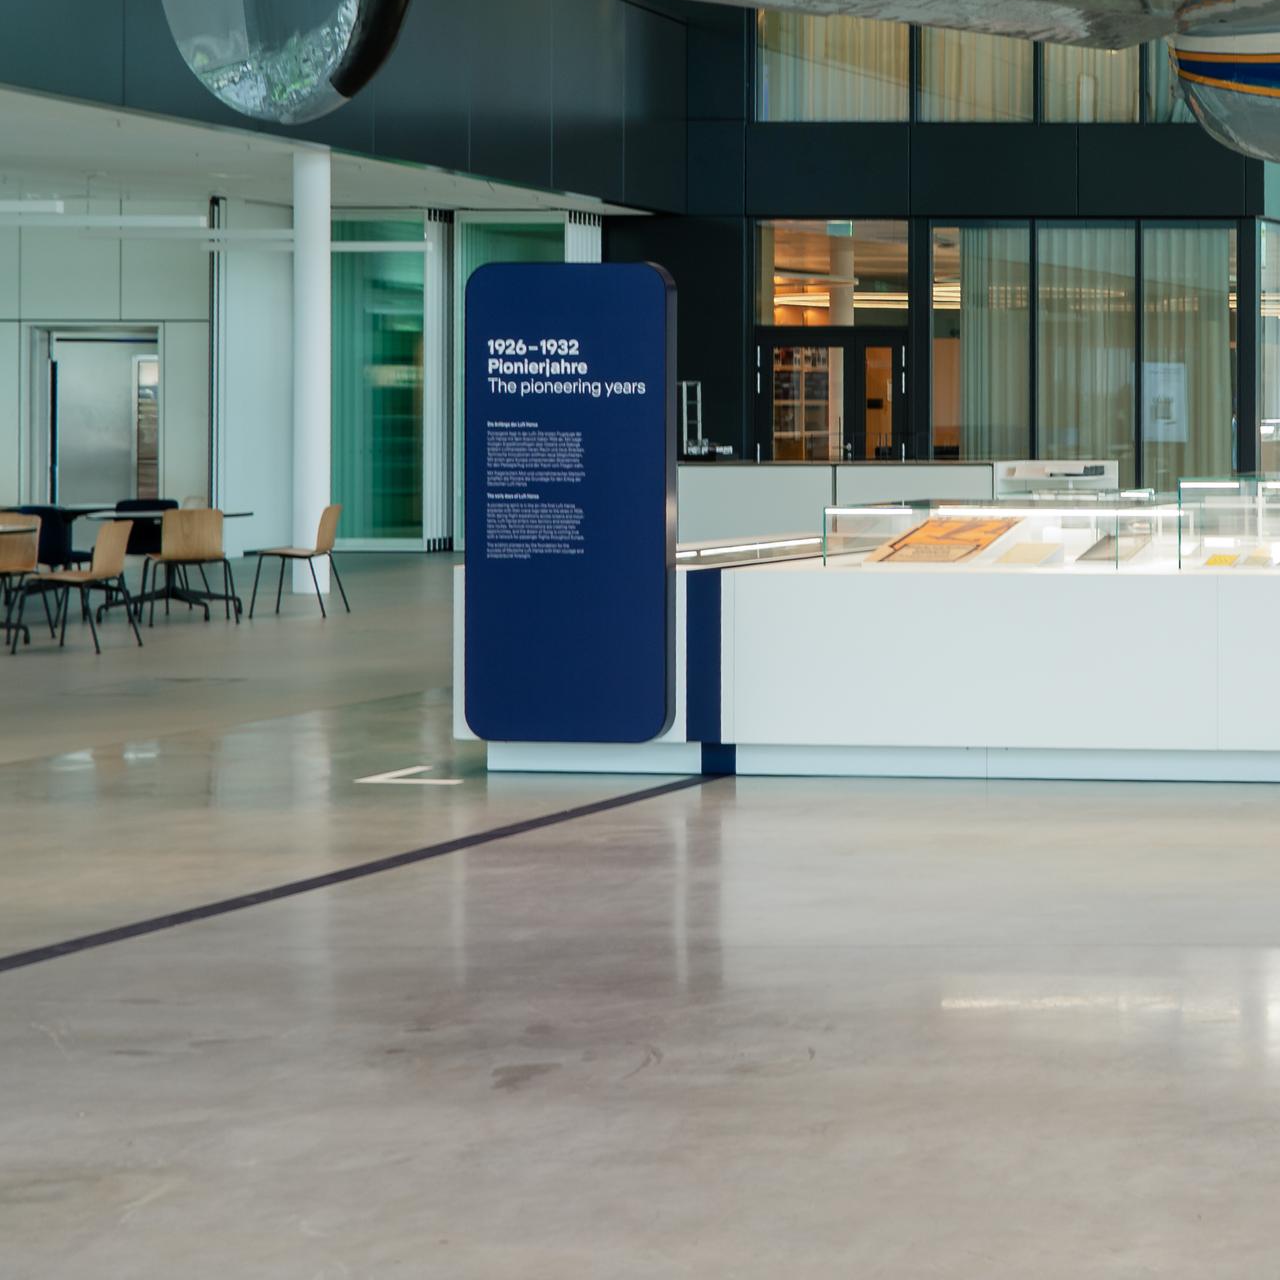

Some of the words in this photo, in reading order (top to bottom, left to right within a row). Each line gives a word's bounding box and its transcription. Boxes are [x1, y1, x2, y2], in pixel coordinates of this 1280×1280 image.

[487, 357, 588, 377] Pionierjahre
[487, 377, 517, 394] The
[520, 378, 602, 398] pioneering
[605, 380, 646, 397] years
